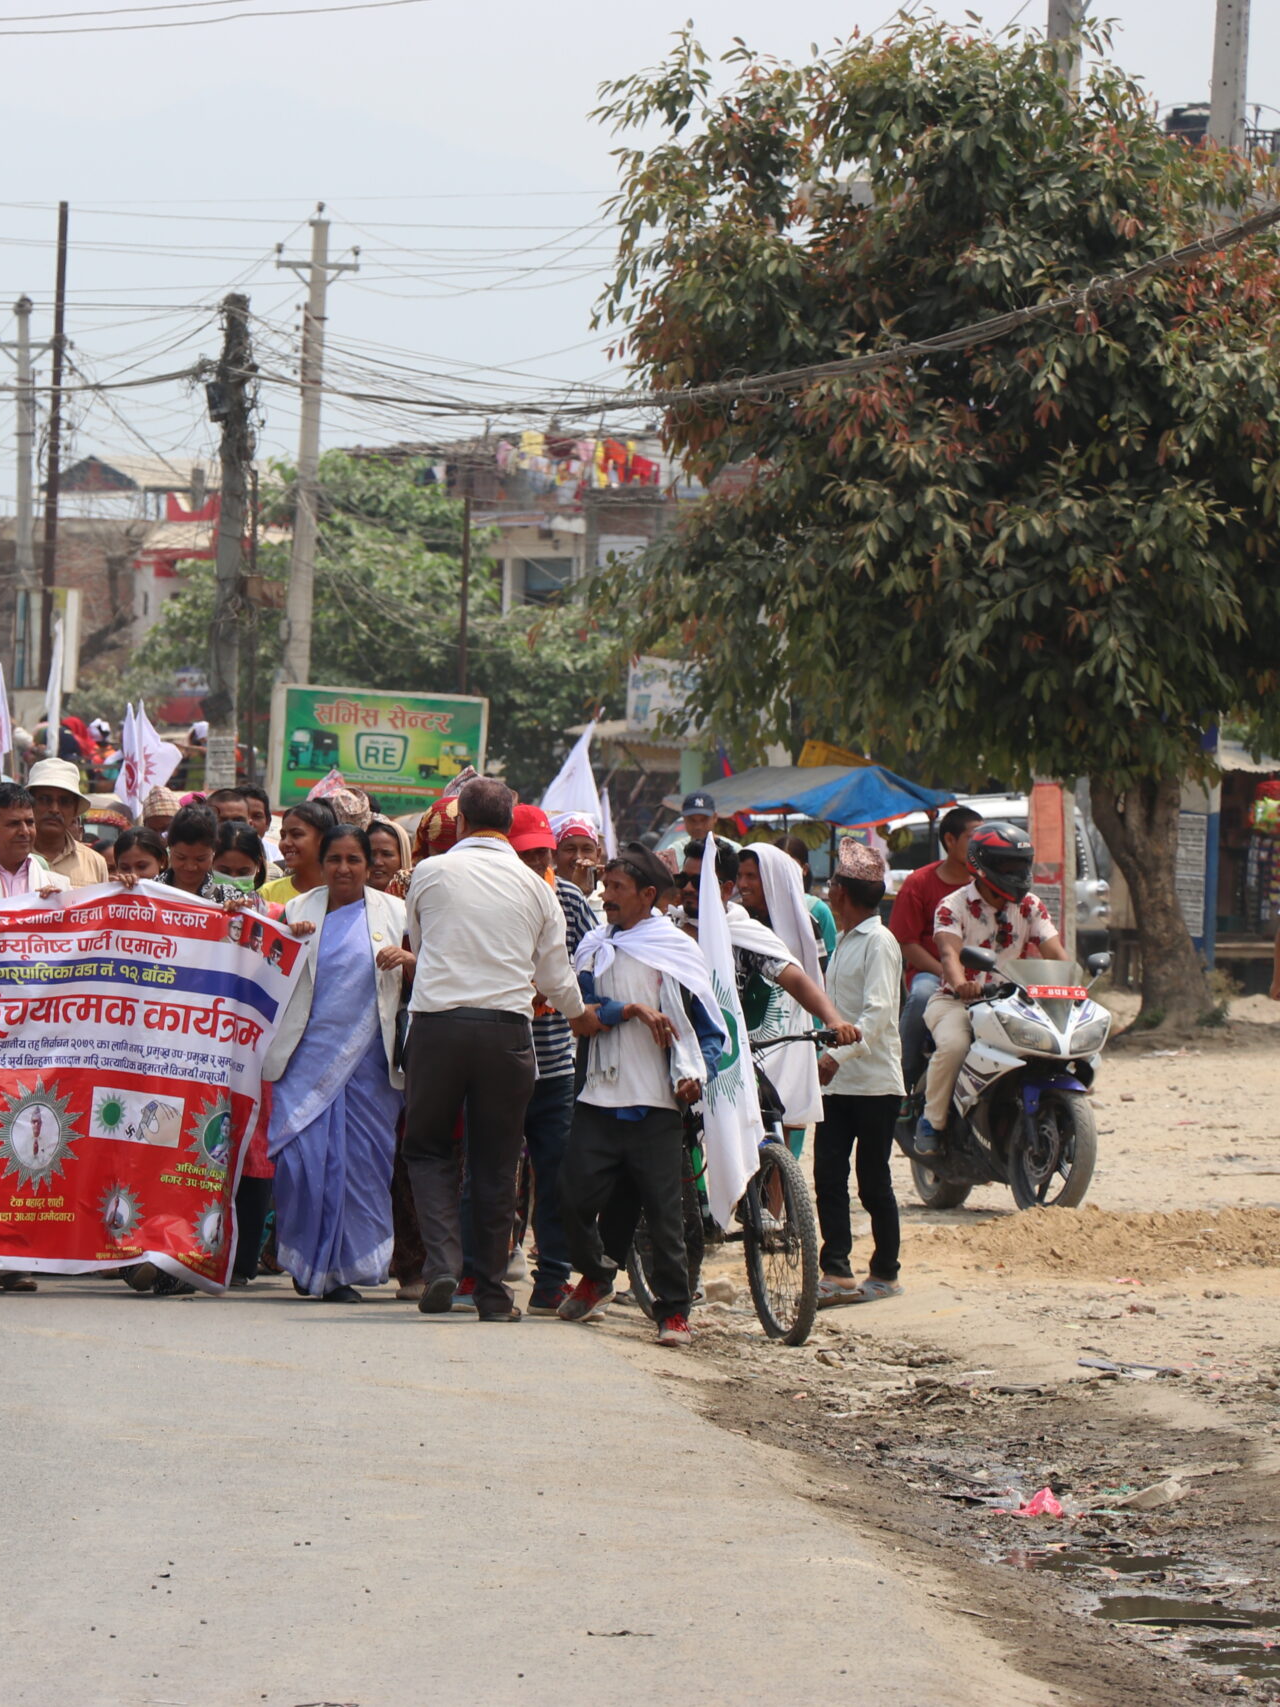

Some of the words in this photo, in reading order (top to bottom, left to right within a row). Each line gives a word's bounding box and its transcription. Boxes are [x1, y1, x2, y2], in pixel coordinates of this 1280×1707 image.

[387, 704, 453, 733] सेन्टर
[365, 746, 396, 765] RE
[70, 906, 103, 924] तहमा
[108, 901, 157, 923] एमालेको
[161, 909, 209, 929] सरकार
[77, 930, 113, 952] पार्टी
[115, 935, 178, 959] (एमाले)
[75, 962, 98, 977] वडा
[160, 1174, 183, 1186] नगर
[9, 1195, 25, 1207] टेक
